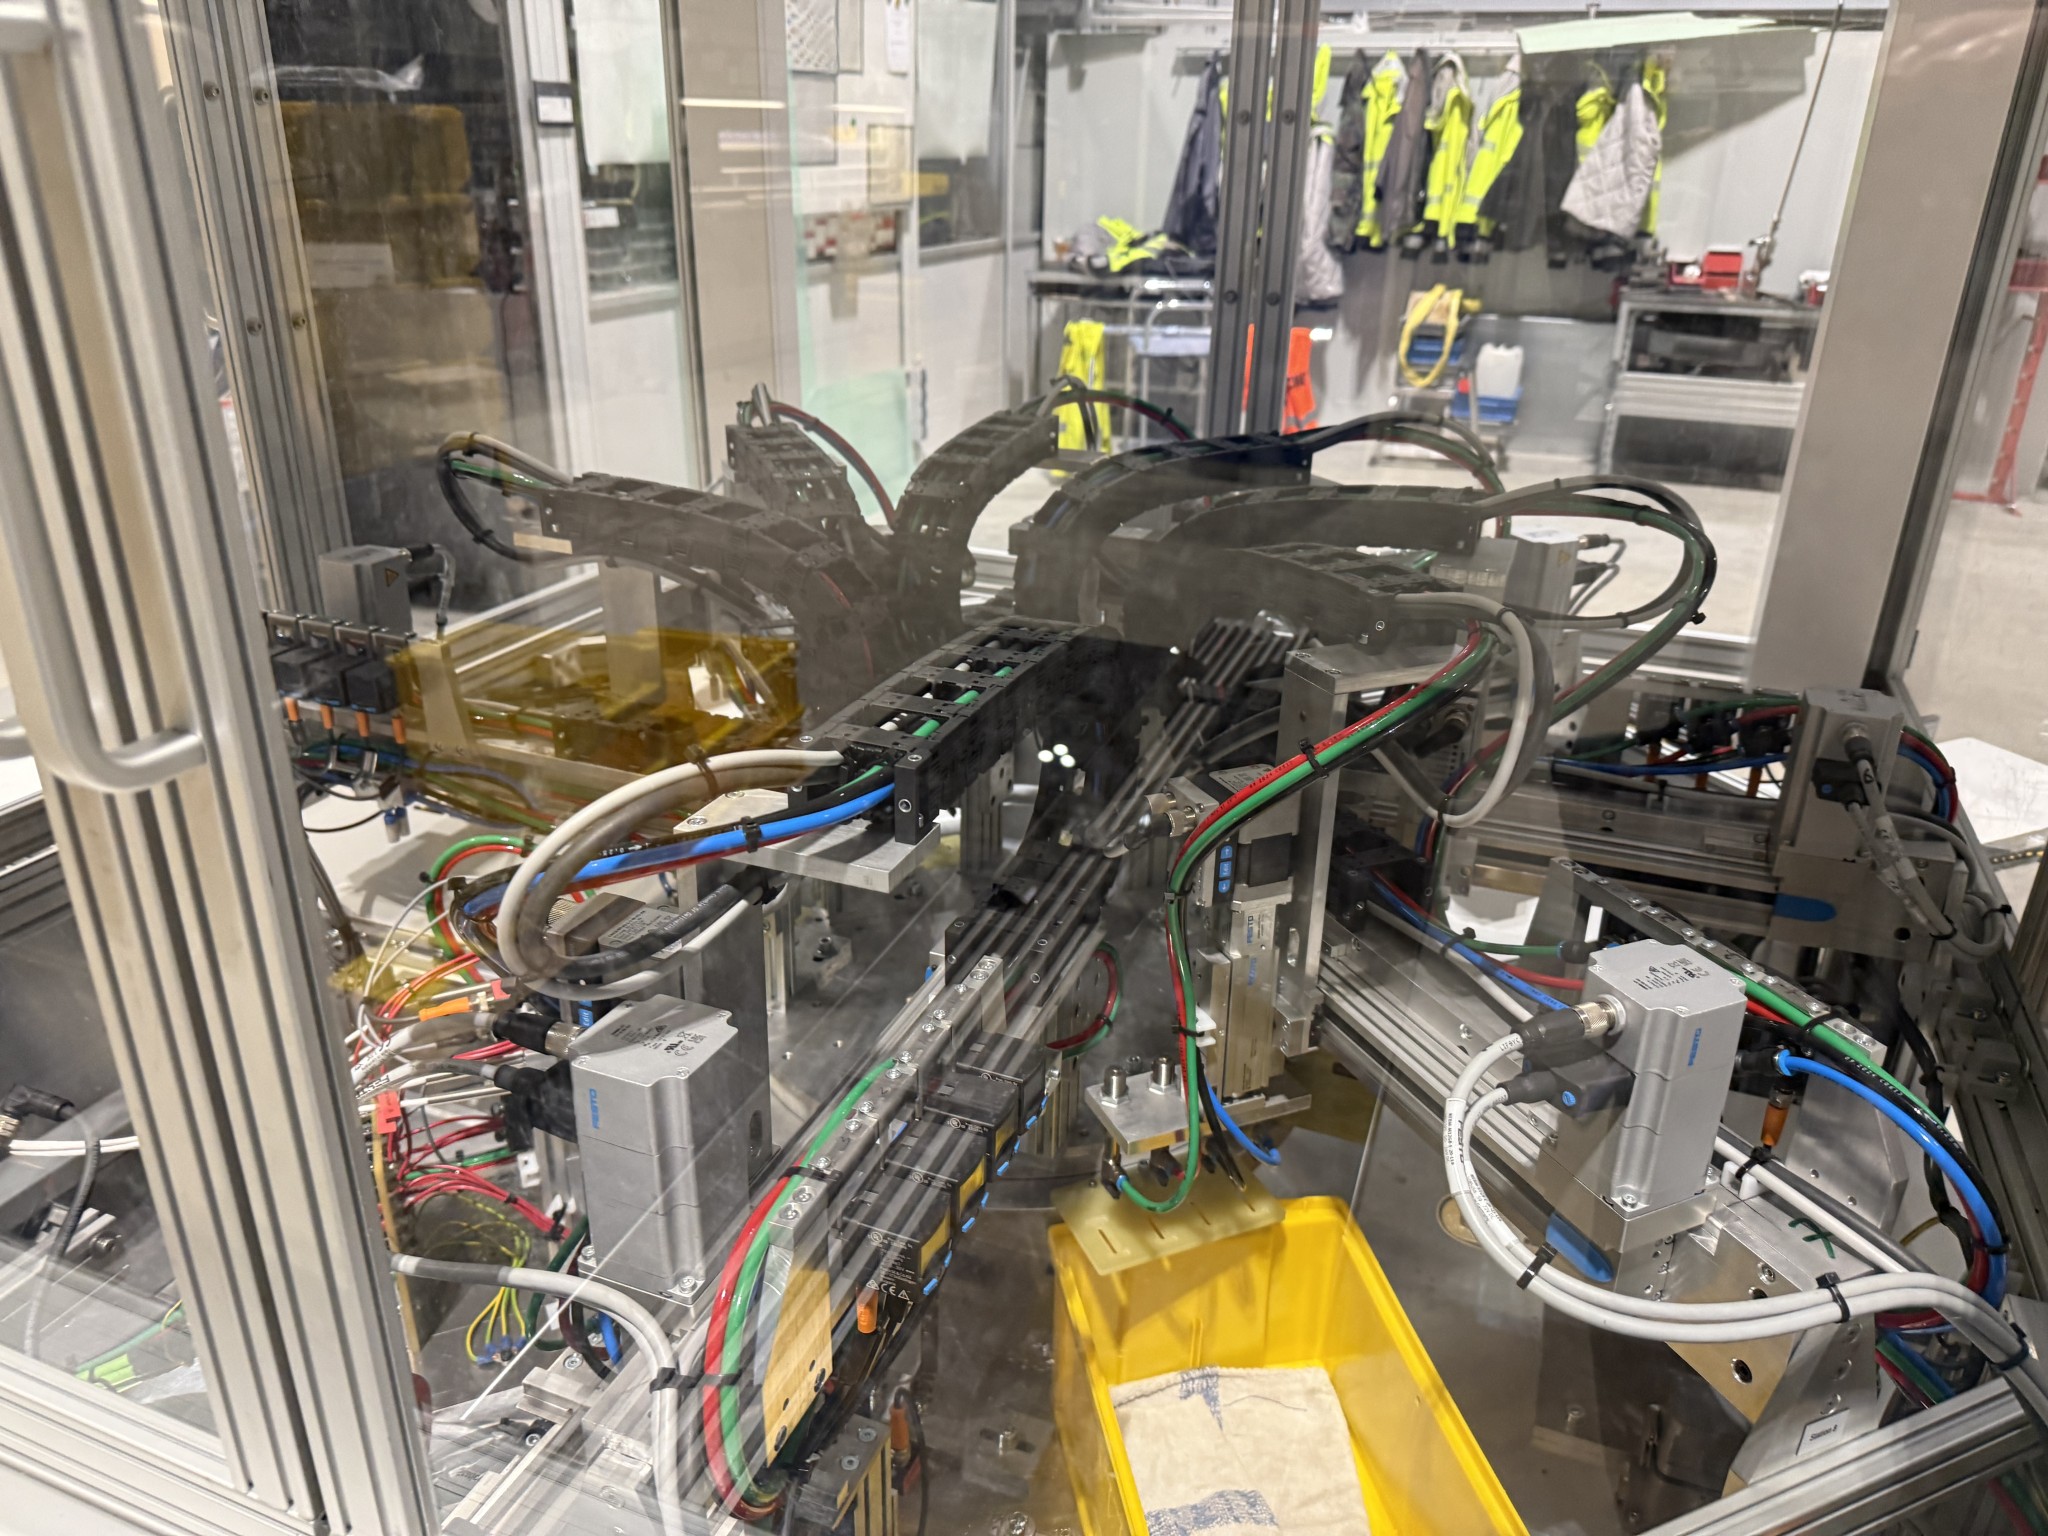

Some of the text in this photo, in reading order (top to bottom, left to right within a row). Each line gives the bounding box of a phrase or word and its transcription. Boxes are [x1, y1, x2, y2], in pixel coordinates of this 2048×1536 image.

[1246, 915, 1254, 944] FESTO
[1687, 1027, 1702, 1067] FESTO
[589, 1088, 600, 1130] FESTO
[880, 1283, 898, 1297] CE
